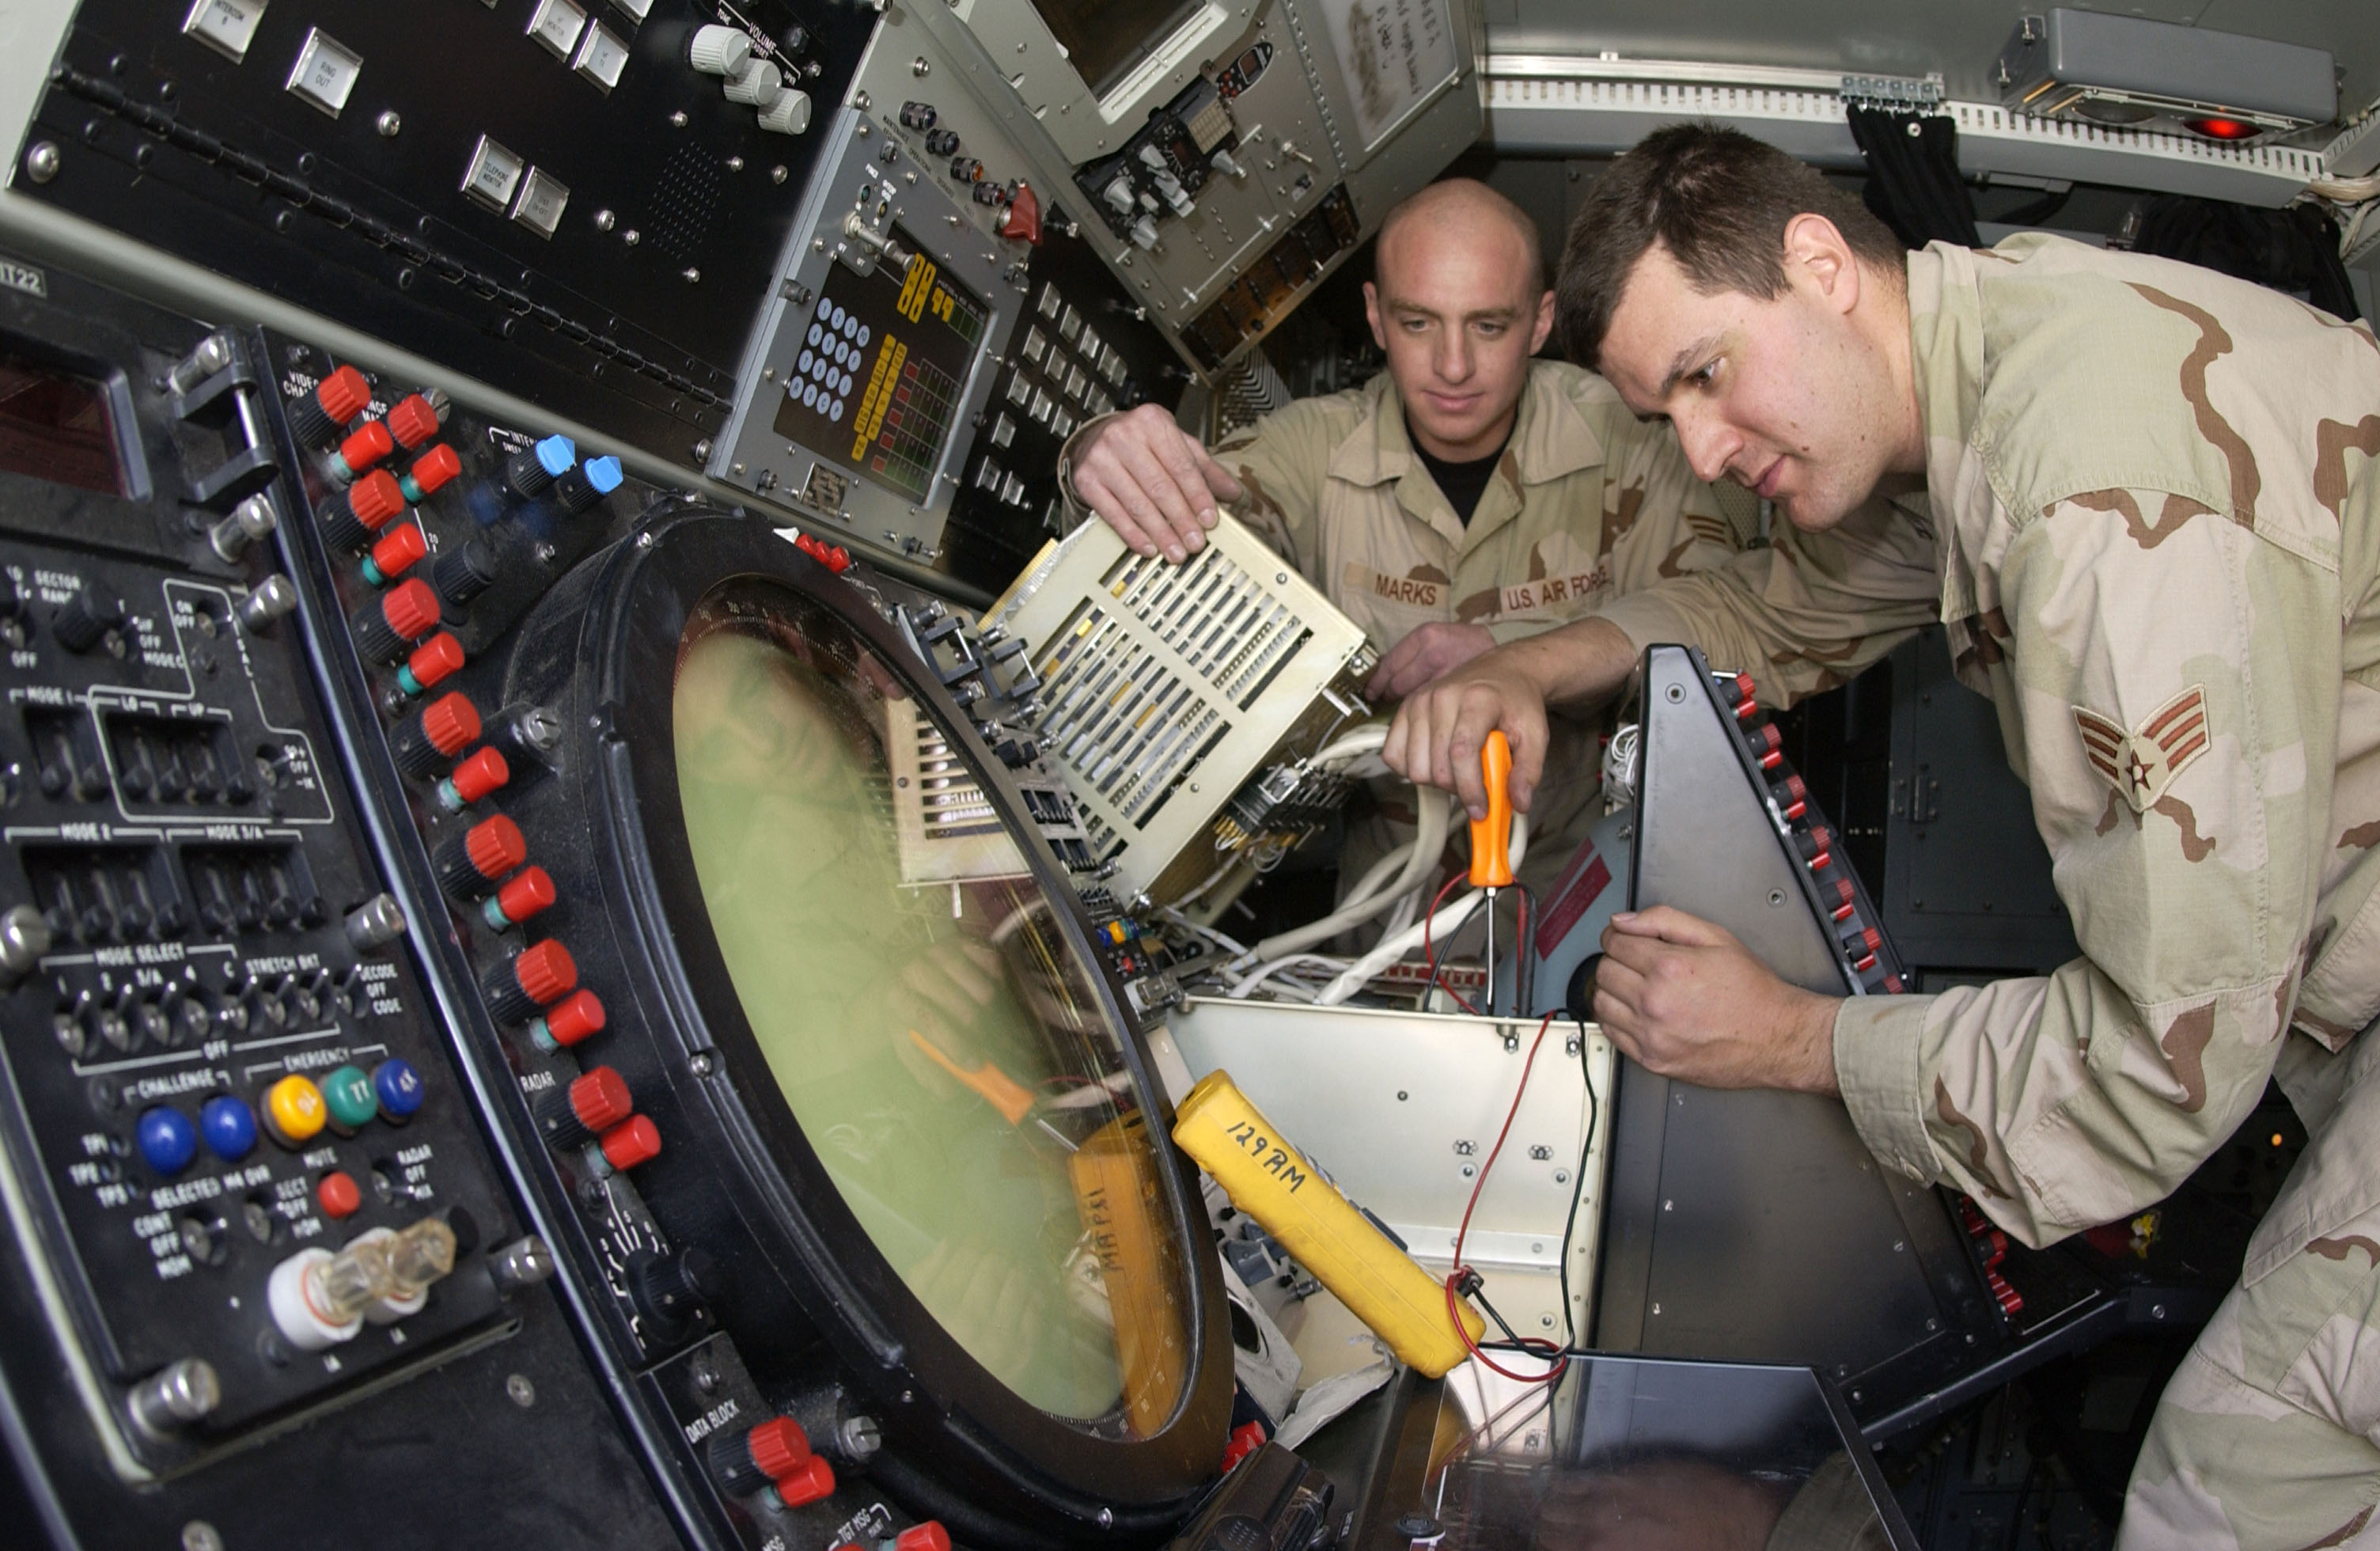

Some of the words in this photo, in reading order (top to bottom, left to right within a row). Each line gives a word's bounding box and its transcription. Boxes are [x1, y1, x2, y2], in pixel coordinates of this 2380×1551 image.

[717, 8, 731, 25] TONE
[749, 22, 776, 55] VOLUME
[320, 61, 337, 78] RING
[315, 74, 331, 88] OUT
[483, 161, 509, 182] TELEPHONE
[34, 570, 81, 591] SECTOR
[1375, 574, 1437, 606] MARKS
[1506, 588, 1536, 611] U.S.
[1542, 579, 1568, 605] AIR
[174, 613, 195, 628] OFF
[138, 633, 161, 649] OFF
[11, 649, 38, 669] OFF
[142, 650, 176, 668] MODE
[27, 686, 63, 704] MODE
[290, 761, 309, 775] OFF
[60, 823, 97, 842] MODE
[206, 824, 237, 840] MODE
[96, 946, 135, 965] MODE
[136, 942, 186, 963] SELECT
[245, 956, 298, 976] STRETCH
[366, 982, 386, 998] OFF
[373, 997, 403, 1015] CODE
[203, 1039, 228, 1060] OFF
[283, 1047, 350, 1072] EMERGENCY
[138, 1068, 218, 1099] CHALLENGE
[520, 1070, 556, 1093] RADAR
[303, 1147, 339, 1169] MUTE
[397, 1143, 434, 1166] RADAR
[405, 1163, 426, 1184] OFF
[151, 1177, 222, 1211] SELECTED
[283, 1196, 309, 1219] OFF
[134, 1210, 173, 1239] CONT
[151, 1231, 179, 1257] OFF
[685, 1419, 712, 1444] DATA
[708, 1397, 741, 1431] BLOCK
[838, 1520, 855, 1545] TGT
[851, 1507, 871, 1532] MSG
